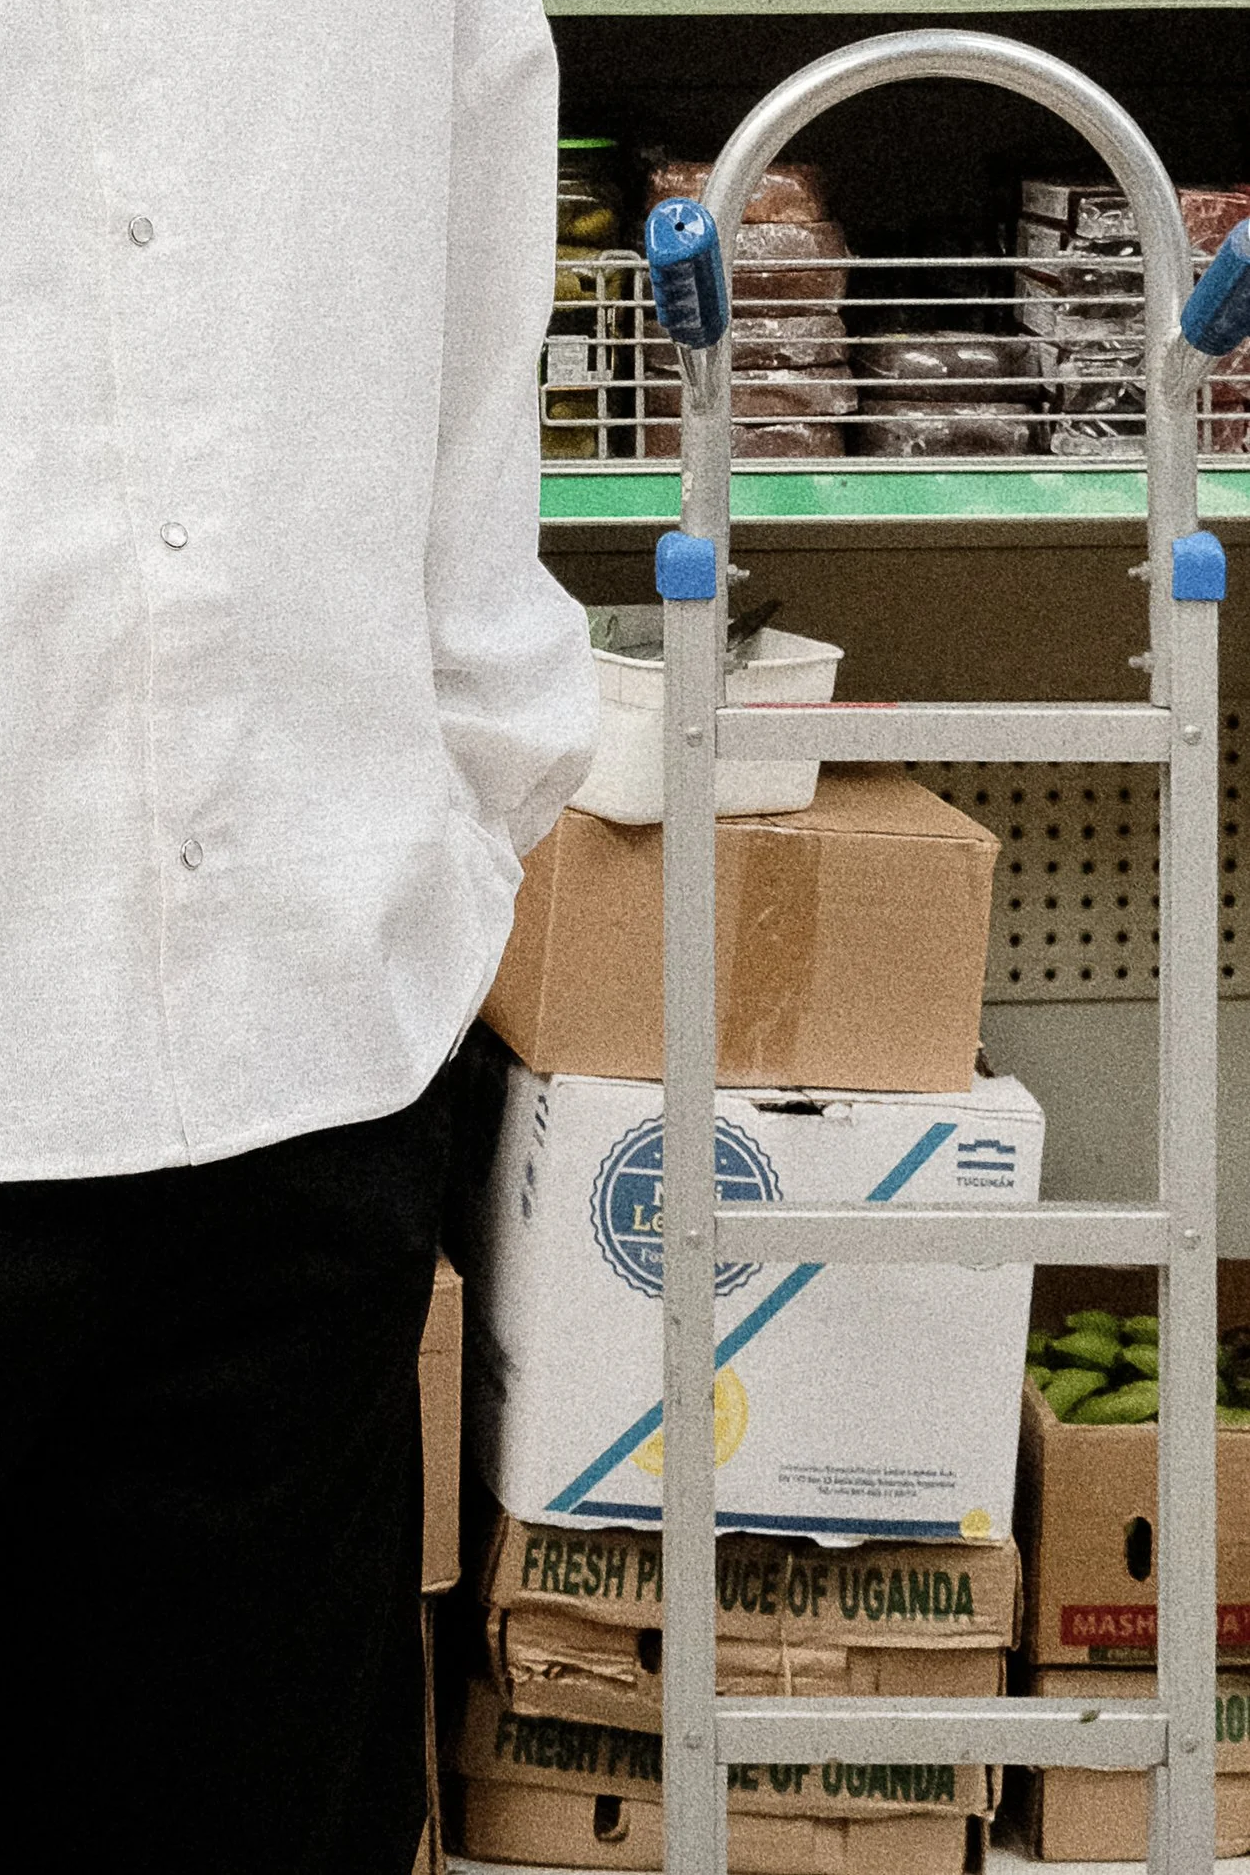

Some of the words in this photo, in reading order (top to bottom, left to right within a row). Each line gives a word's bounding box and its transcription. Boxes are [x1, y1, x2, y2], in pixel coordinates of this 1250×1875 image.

[521, 1536, 627, 1598] FRESH
[788, 1568, 827, 1618] OF
[839, 1568, 975, 1623] UGANDA
[496, 1713, 598, 1775] FRESH
[822, 1764, 954, 1803] UGANDA
